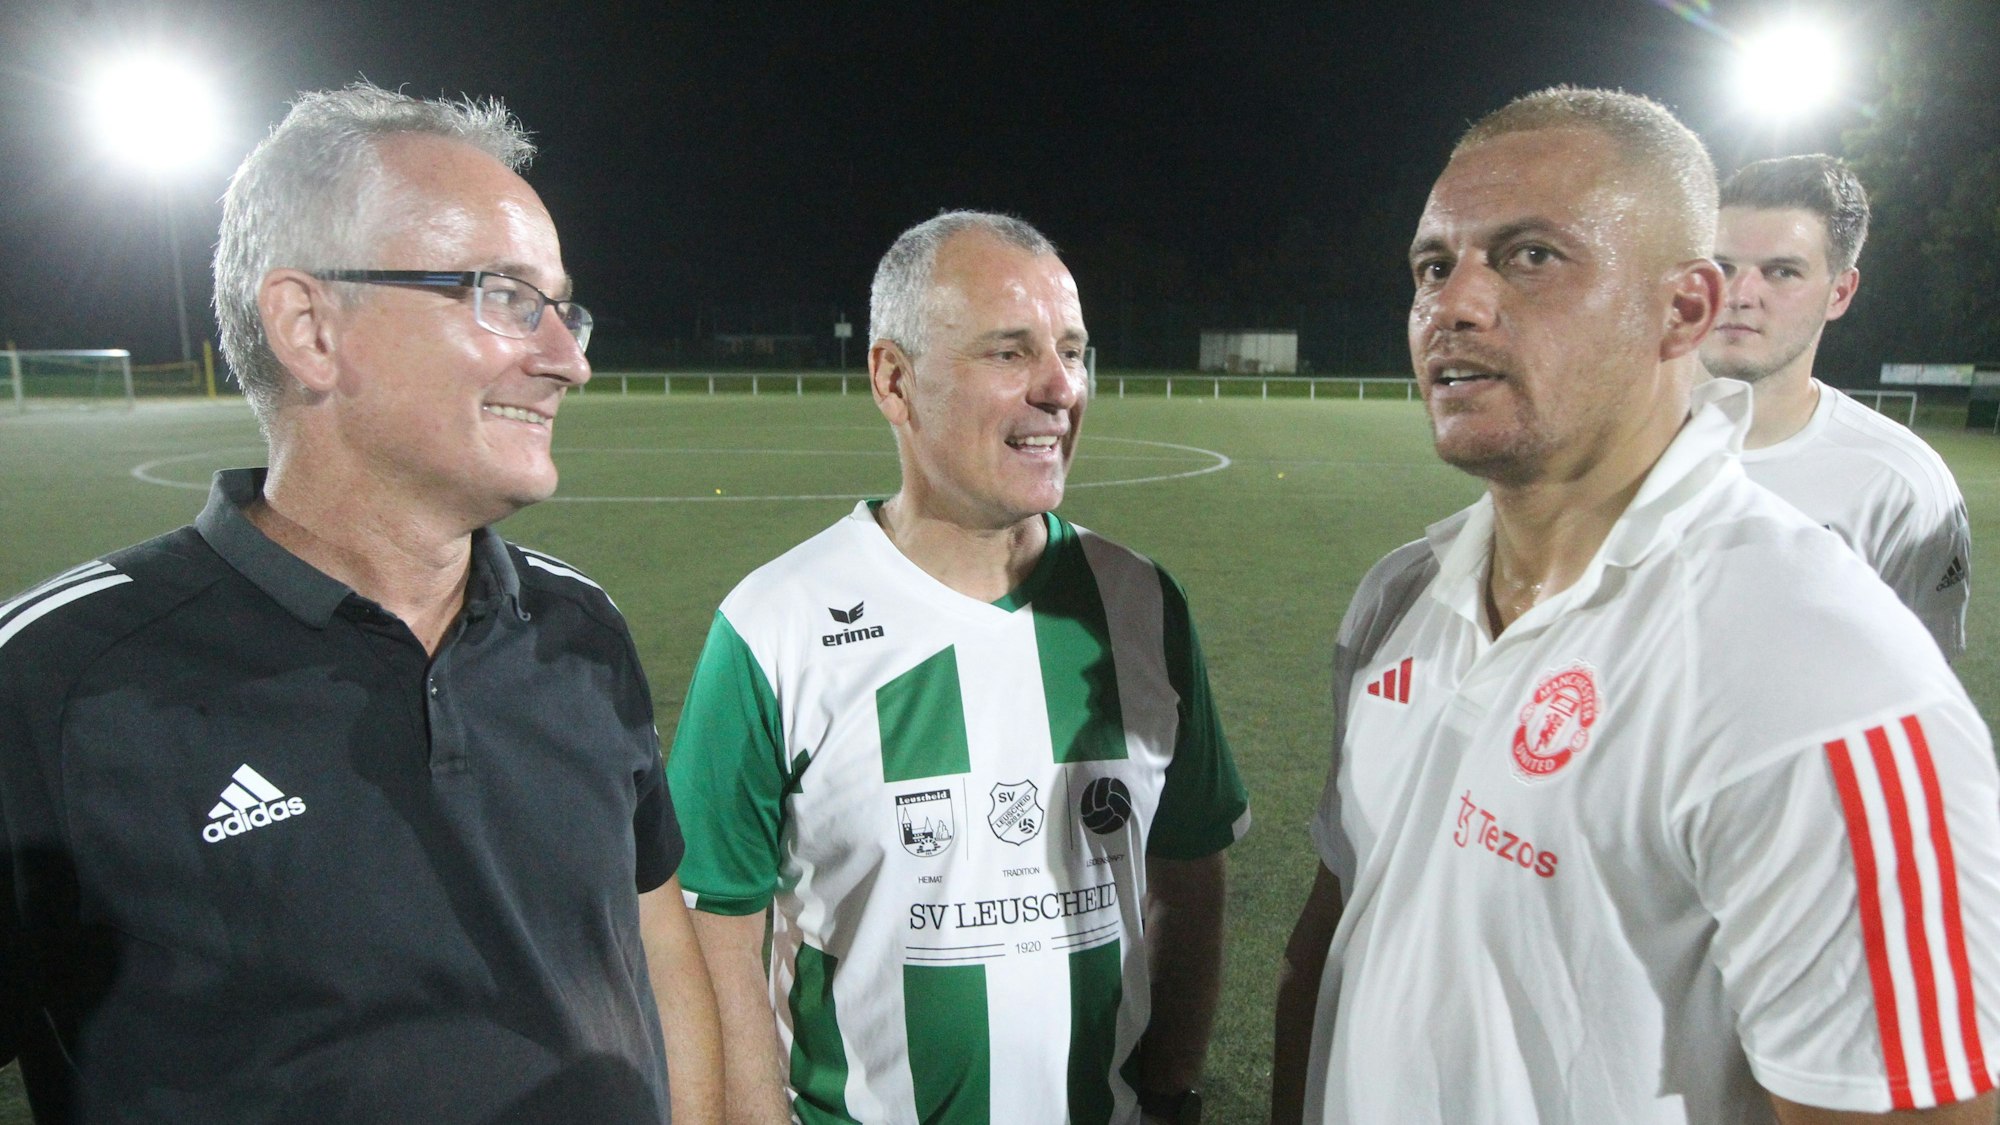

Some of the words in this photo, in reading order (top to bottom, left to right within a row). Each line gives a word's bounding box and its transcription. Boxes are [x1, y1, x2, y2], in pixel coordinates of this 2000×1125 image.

[822, 625, 884, 647] erima
[1536, 674, 1594, 722] MANCHESTER
[1515, 741, 1556, 772] UNITED
[898, 791, 947, 805] Leuscheid
[998, 791, 1016, 803] SV
[202, 796, 306, 844] adidas
[995, 794, 1031, 828] LEUSCHEID
[1478, 809, 1559, 878] Tezos
[918, 875, 943, 884] HEIMAT
[1002, 867, 1040, 877] TRADITION
[910, 903, 949, 930] SV
[954, 881, 1118, 928] LEUSCHEID
[1016, 941, 1042, 954] 1920
